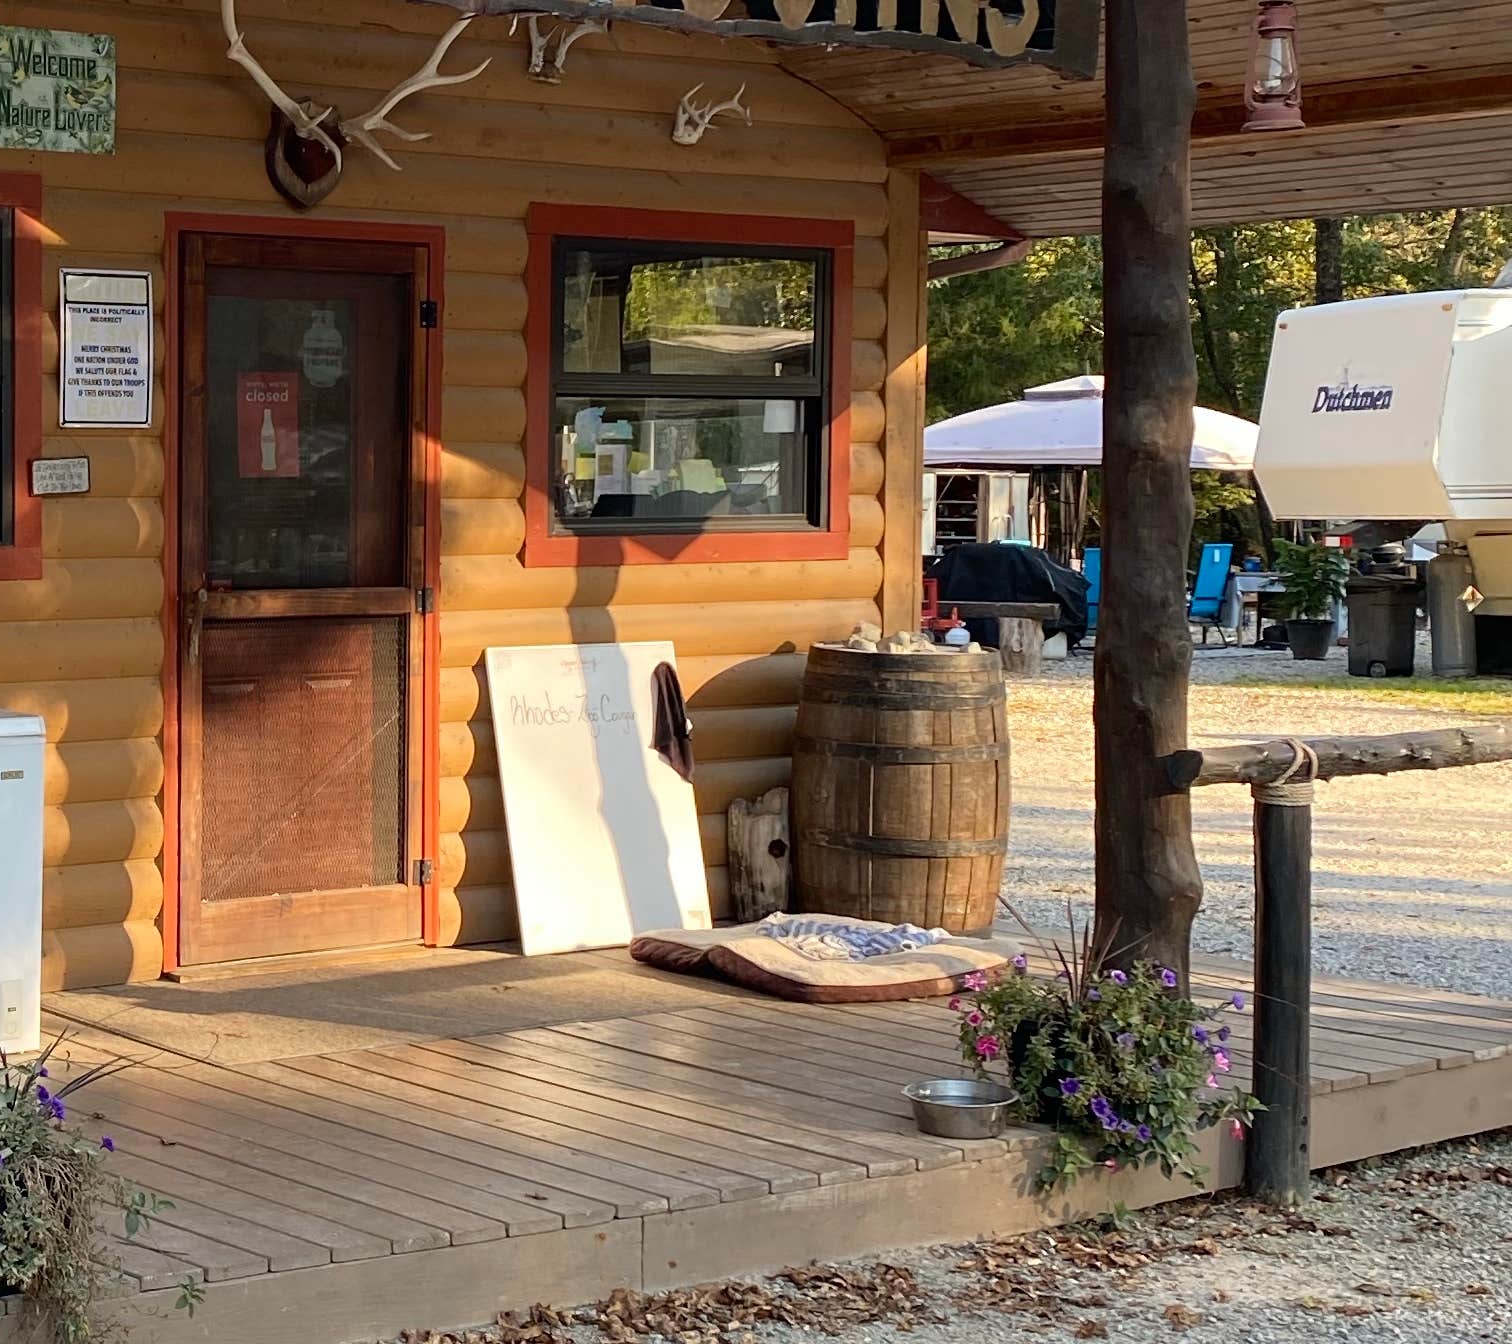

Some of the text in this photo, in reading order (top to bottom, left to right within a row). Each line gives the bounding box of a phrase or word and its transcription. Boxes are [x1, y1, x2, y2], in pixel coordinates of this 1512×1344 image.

[9, 37, 98, 80] Welcome
[53, 90, 112, 132] Lovers
[108, 308, 145, 316] POLITICALLY
[81, 345, 132, 353] MERRY CHRISTMAS
[73, 356, 85, 364] ONE
[86, 356, 106, 364] NATION
[126, 357, 139, 365] GOD
[75, 367, 84, 375] WE
[84, 367, 105, 375] SALUTE
[118, 368, 132, 376] FLAG
[67, 378, 80, 386] GIVE
[124, 379, 146, 387] TROOPS
[84, 390, 97, 398] THIS
[97, 390, 122, 398] OFFENDS
[246, 389, 289, 402] closed
[1311, 384, 1394, 413] Dutchmen
